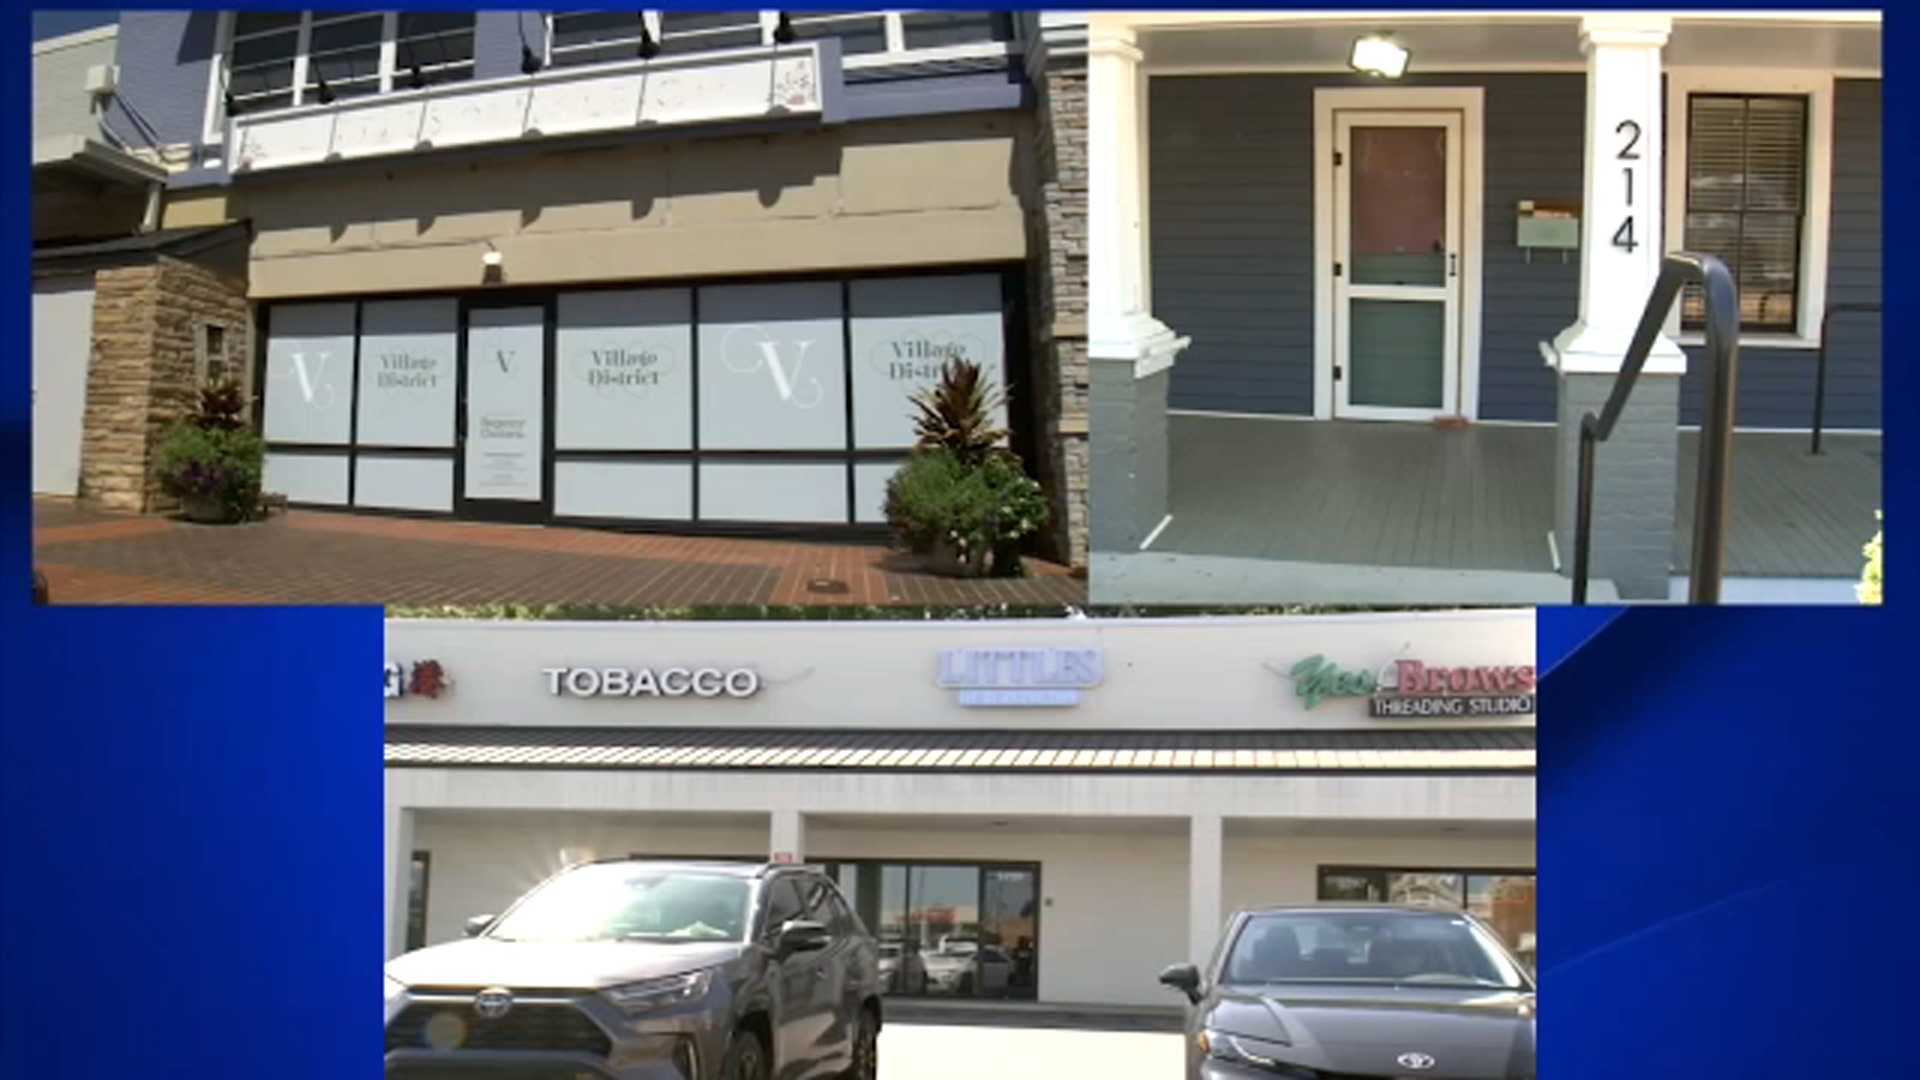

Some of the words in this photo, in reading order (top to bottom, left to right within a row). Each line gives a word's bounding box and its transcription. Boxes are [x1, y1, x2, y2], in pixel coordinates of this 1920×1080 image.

[1611, 119, 1642, 254] 214
[591, 349, 658, 367] Village
[891, 340, 967, 358] Village
[381, 353, 437, 371] Village
[377, 373, 437, 388] District
[588, 369, 659, 386] District
[939, 649, 1101, 685] LITTLES
[542, 667, 761, 698] TOBACCO
[1374, 700, 1462, 716] THREADING
[1468, 697, 1531, 714] STUDIO
